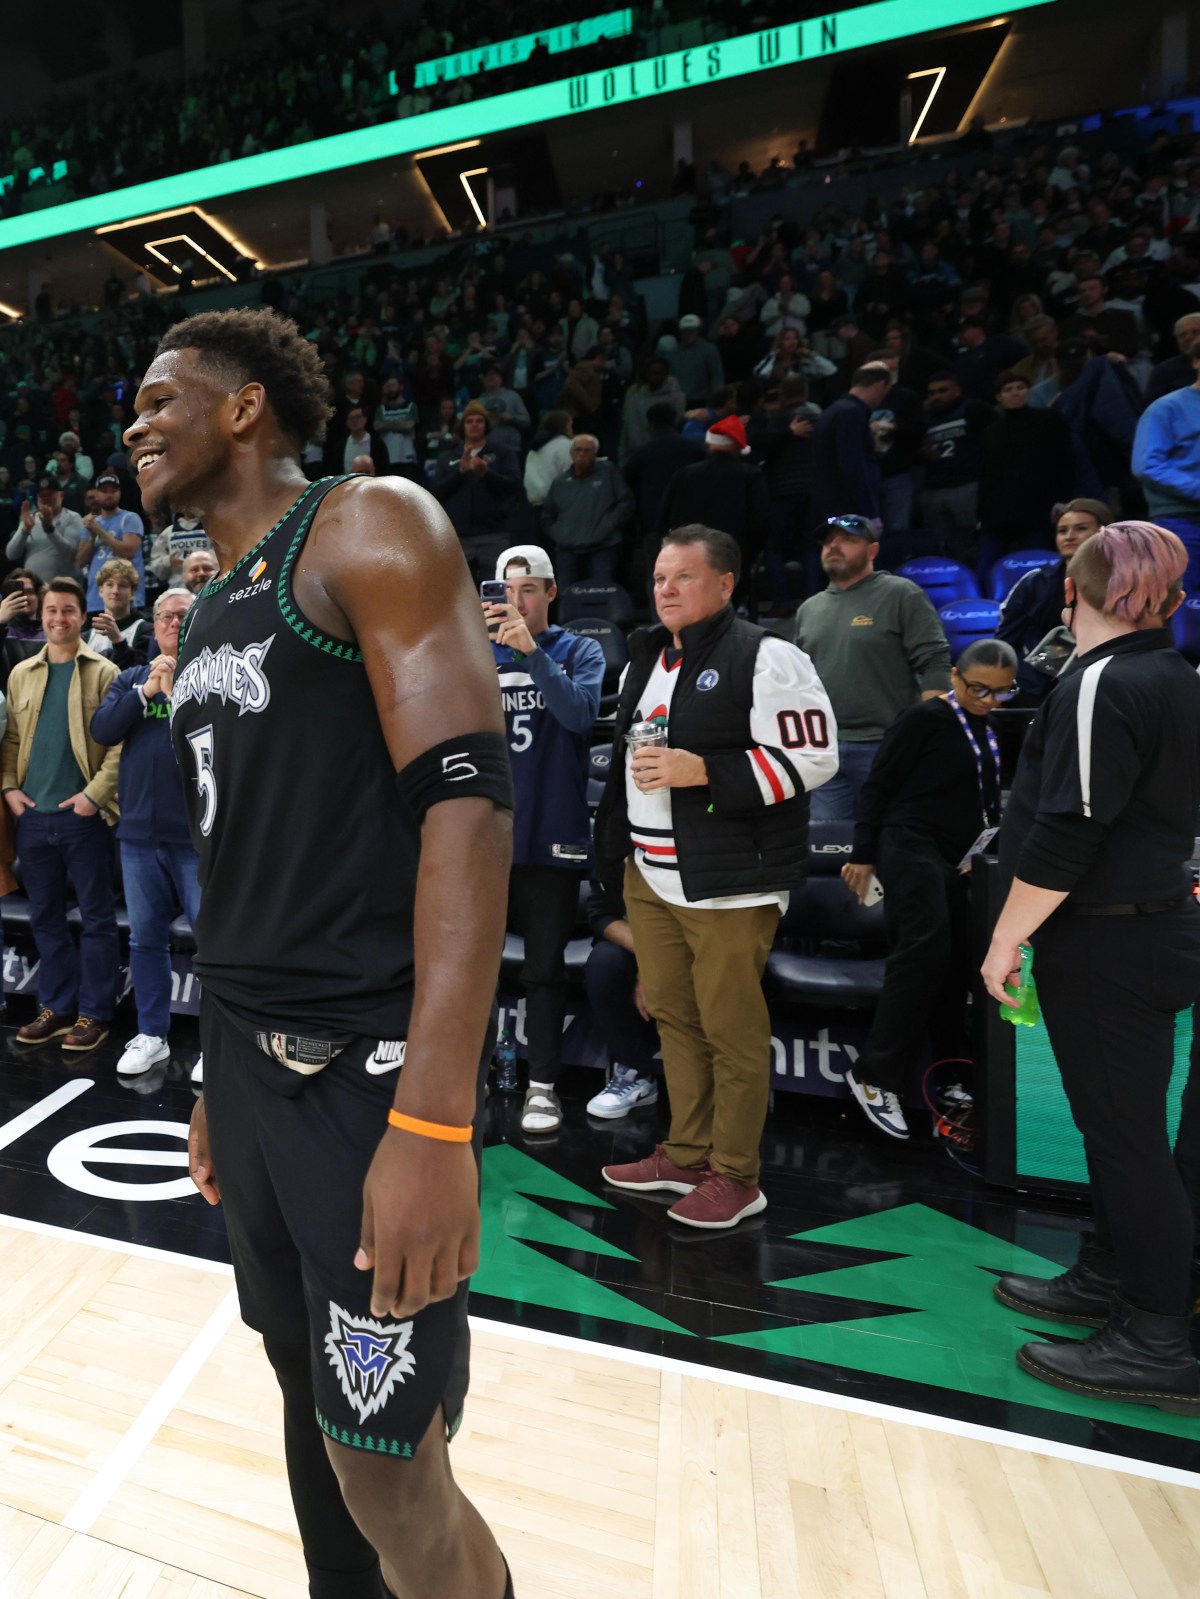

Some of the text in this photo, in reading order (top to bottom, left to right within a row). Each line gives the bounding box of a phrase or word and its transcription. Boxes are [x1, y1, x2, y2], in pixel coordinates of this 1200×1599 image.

[758, 16, 838, 65] WIN
[171, 540, 208, 550] WOLVES
[227, 577, 273, 604] sezzle
[510, 714, 533, 753] 5
[776, 708, 830, 750] 00
[185, 723, 218, 838] 5
[441, 751, 480, 783] 5
